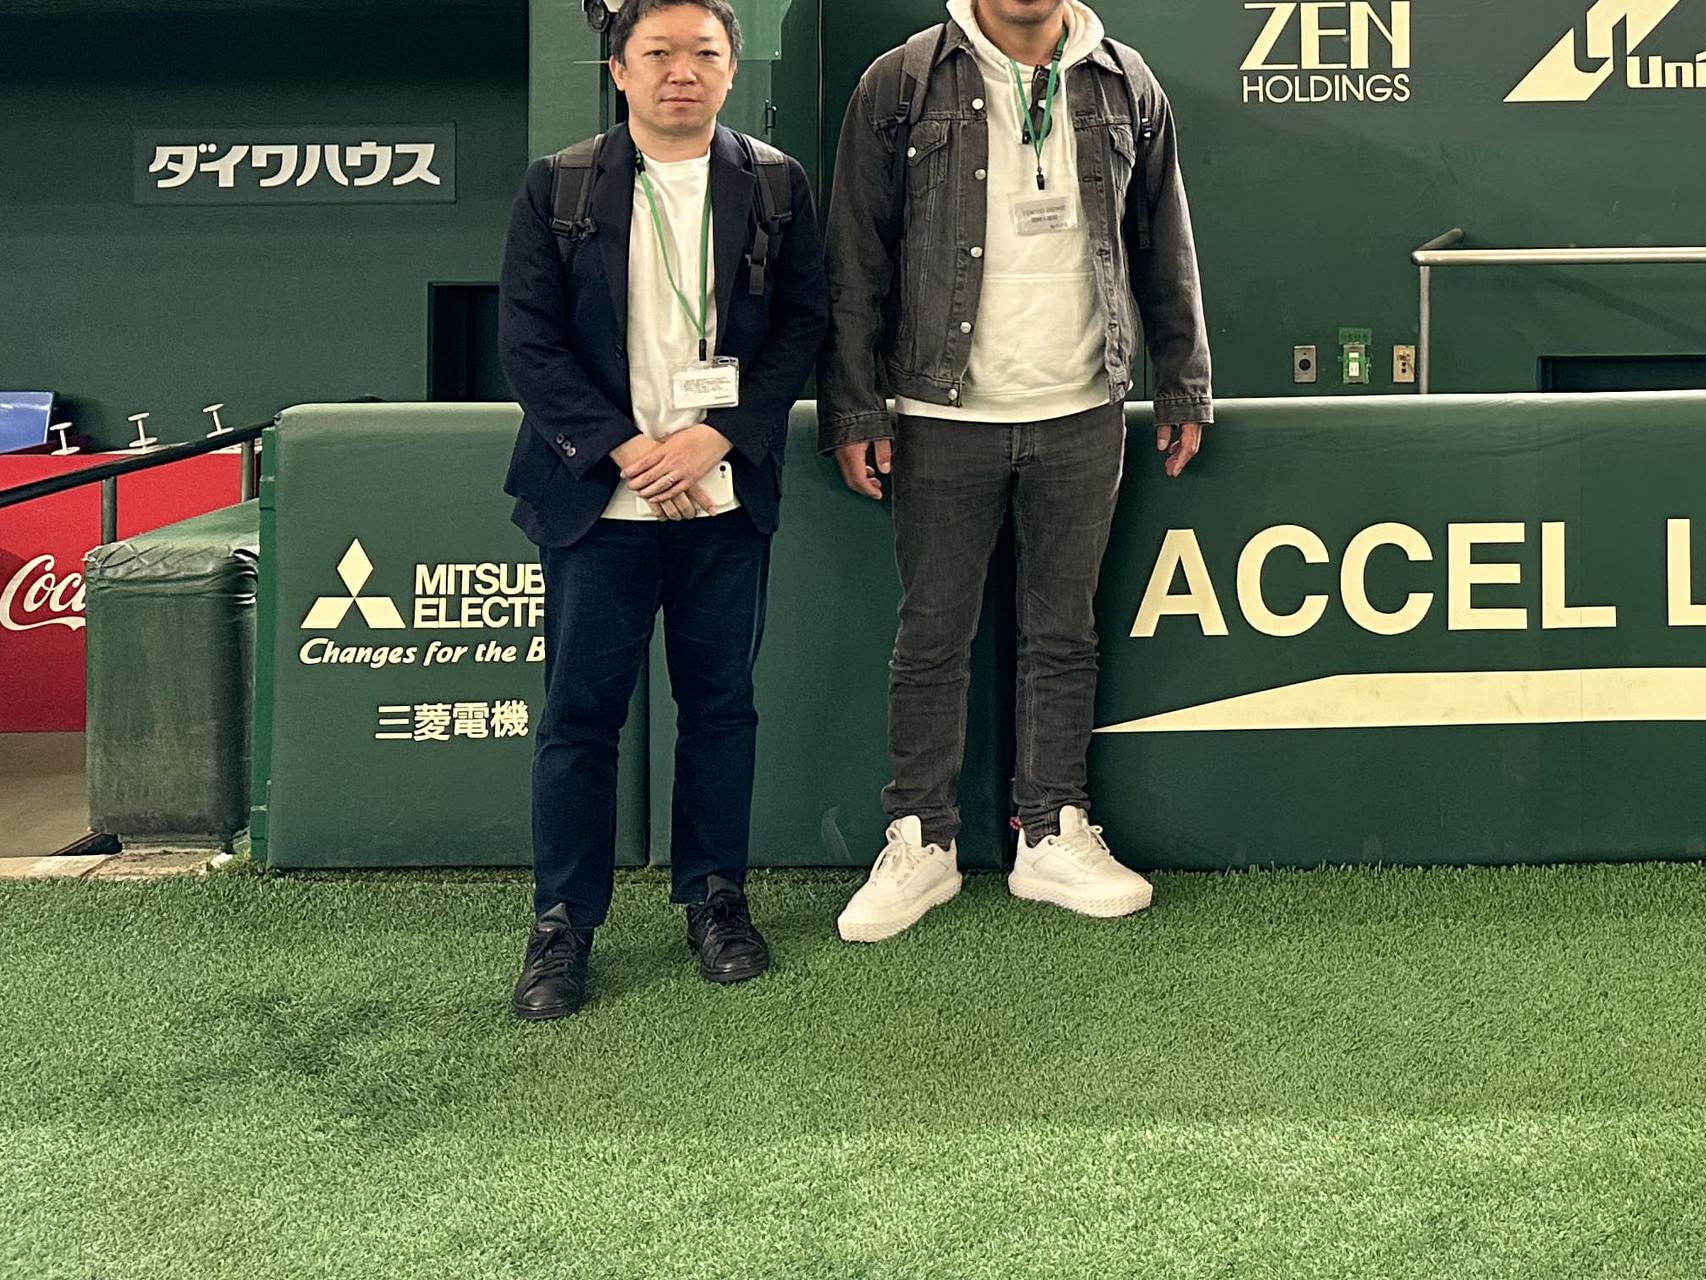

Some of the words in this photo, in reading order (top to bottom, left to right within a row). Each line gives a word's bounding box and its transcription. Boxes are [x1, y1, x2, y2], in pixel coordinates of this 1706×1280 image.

[1239, 0, 1411, 71] ZEN
[1242, 74, 1411, 104] HOLDINGS
[148, 140, 441, 188] ダイワハウス
[1129, 521, 1617, 638] ACCEL
[299, 637, 418, 669] Changes
[422, 640, 469, 667] for
[474, 639, 518, 663] the
[374, 699, 530, 742] 三菱電機
